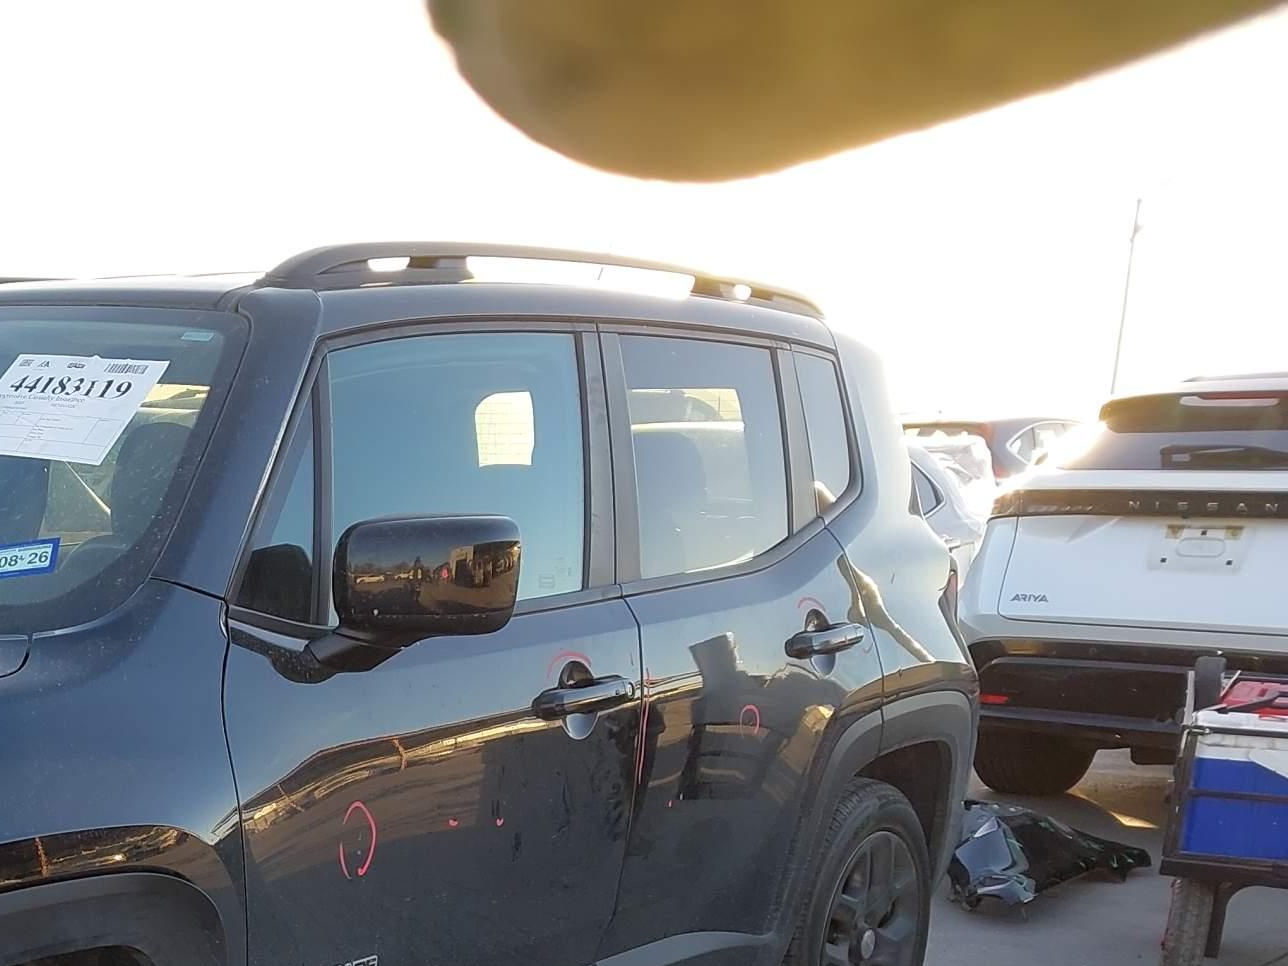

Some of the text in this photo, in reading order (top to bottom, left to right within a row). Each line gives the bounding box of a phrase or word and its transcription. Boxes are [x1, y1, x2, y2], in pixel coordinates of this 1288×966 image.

[10, 374, 133, 399] 44183119
[1128, 500, 1279, 513] NISSAN
[27, 551, 49, 564] 26
[1010, 593, 1049, 603] ARIYA
